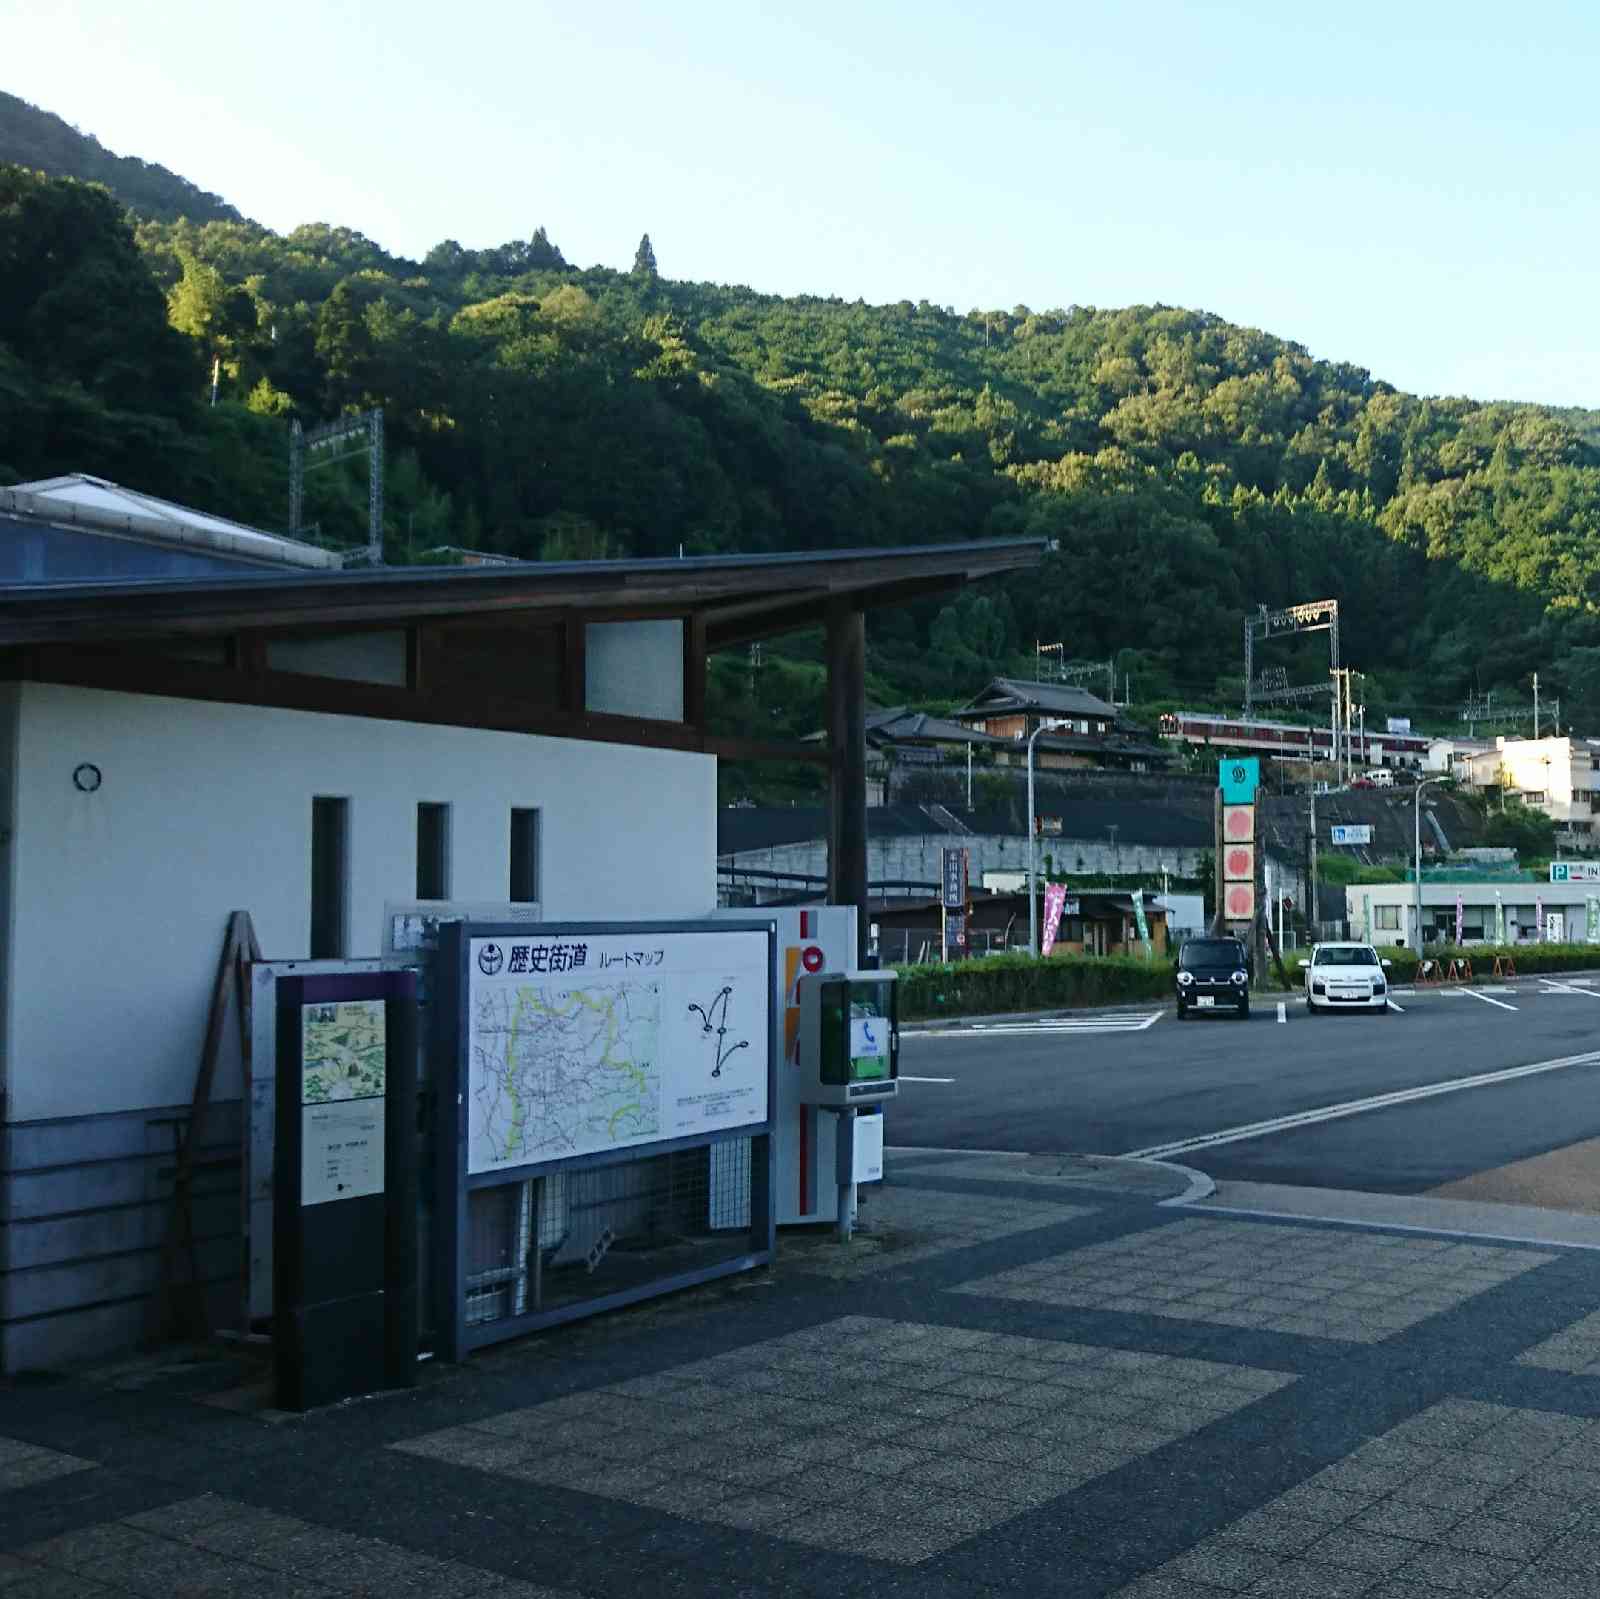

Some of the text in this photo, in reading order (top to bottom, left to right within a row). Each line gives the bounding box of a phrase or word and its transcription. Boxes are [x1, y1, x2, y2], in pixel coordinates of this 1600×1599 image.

[508, 943, 665, 973] 歴史街道 ルートマップ
